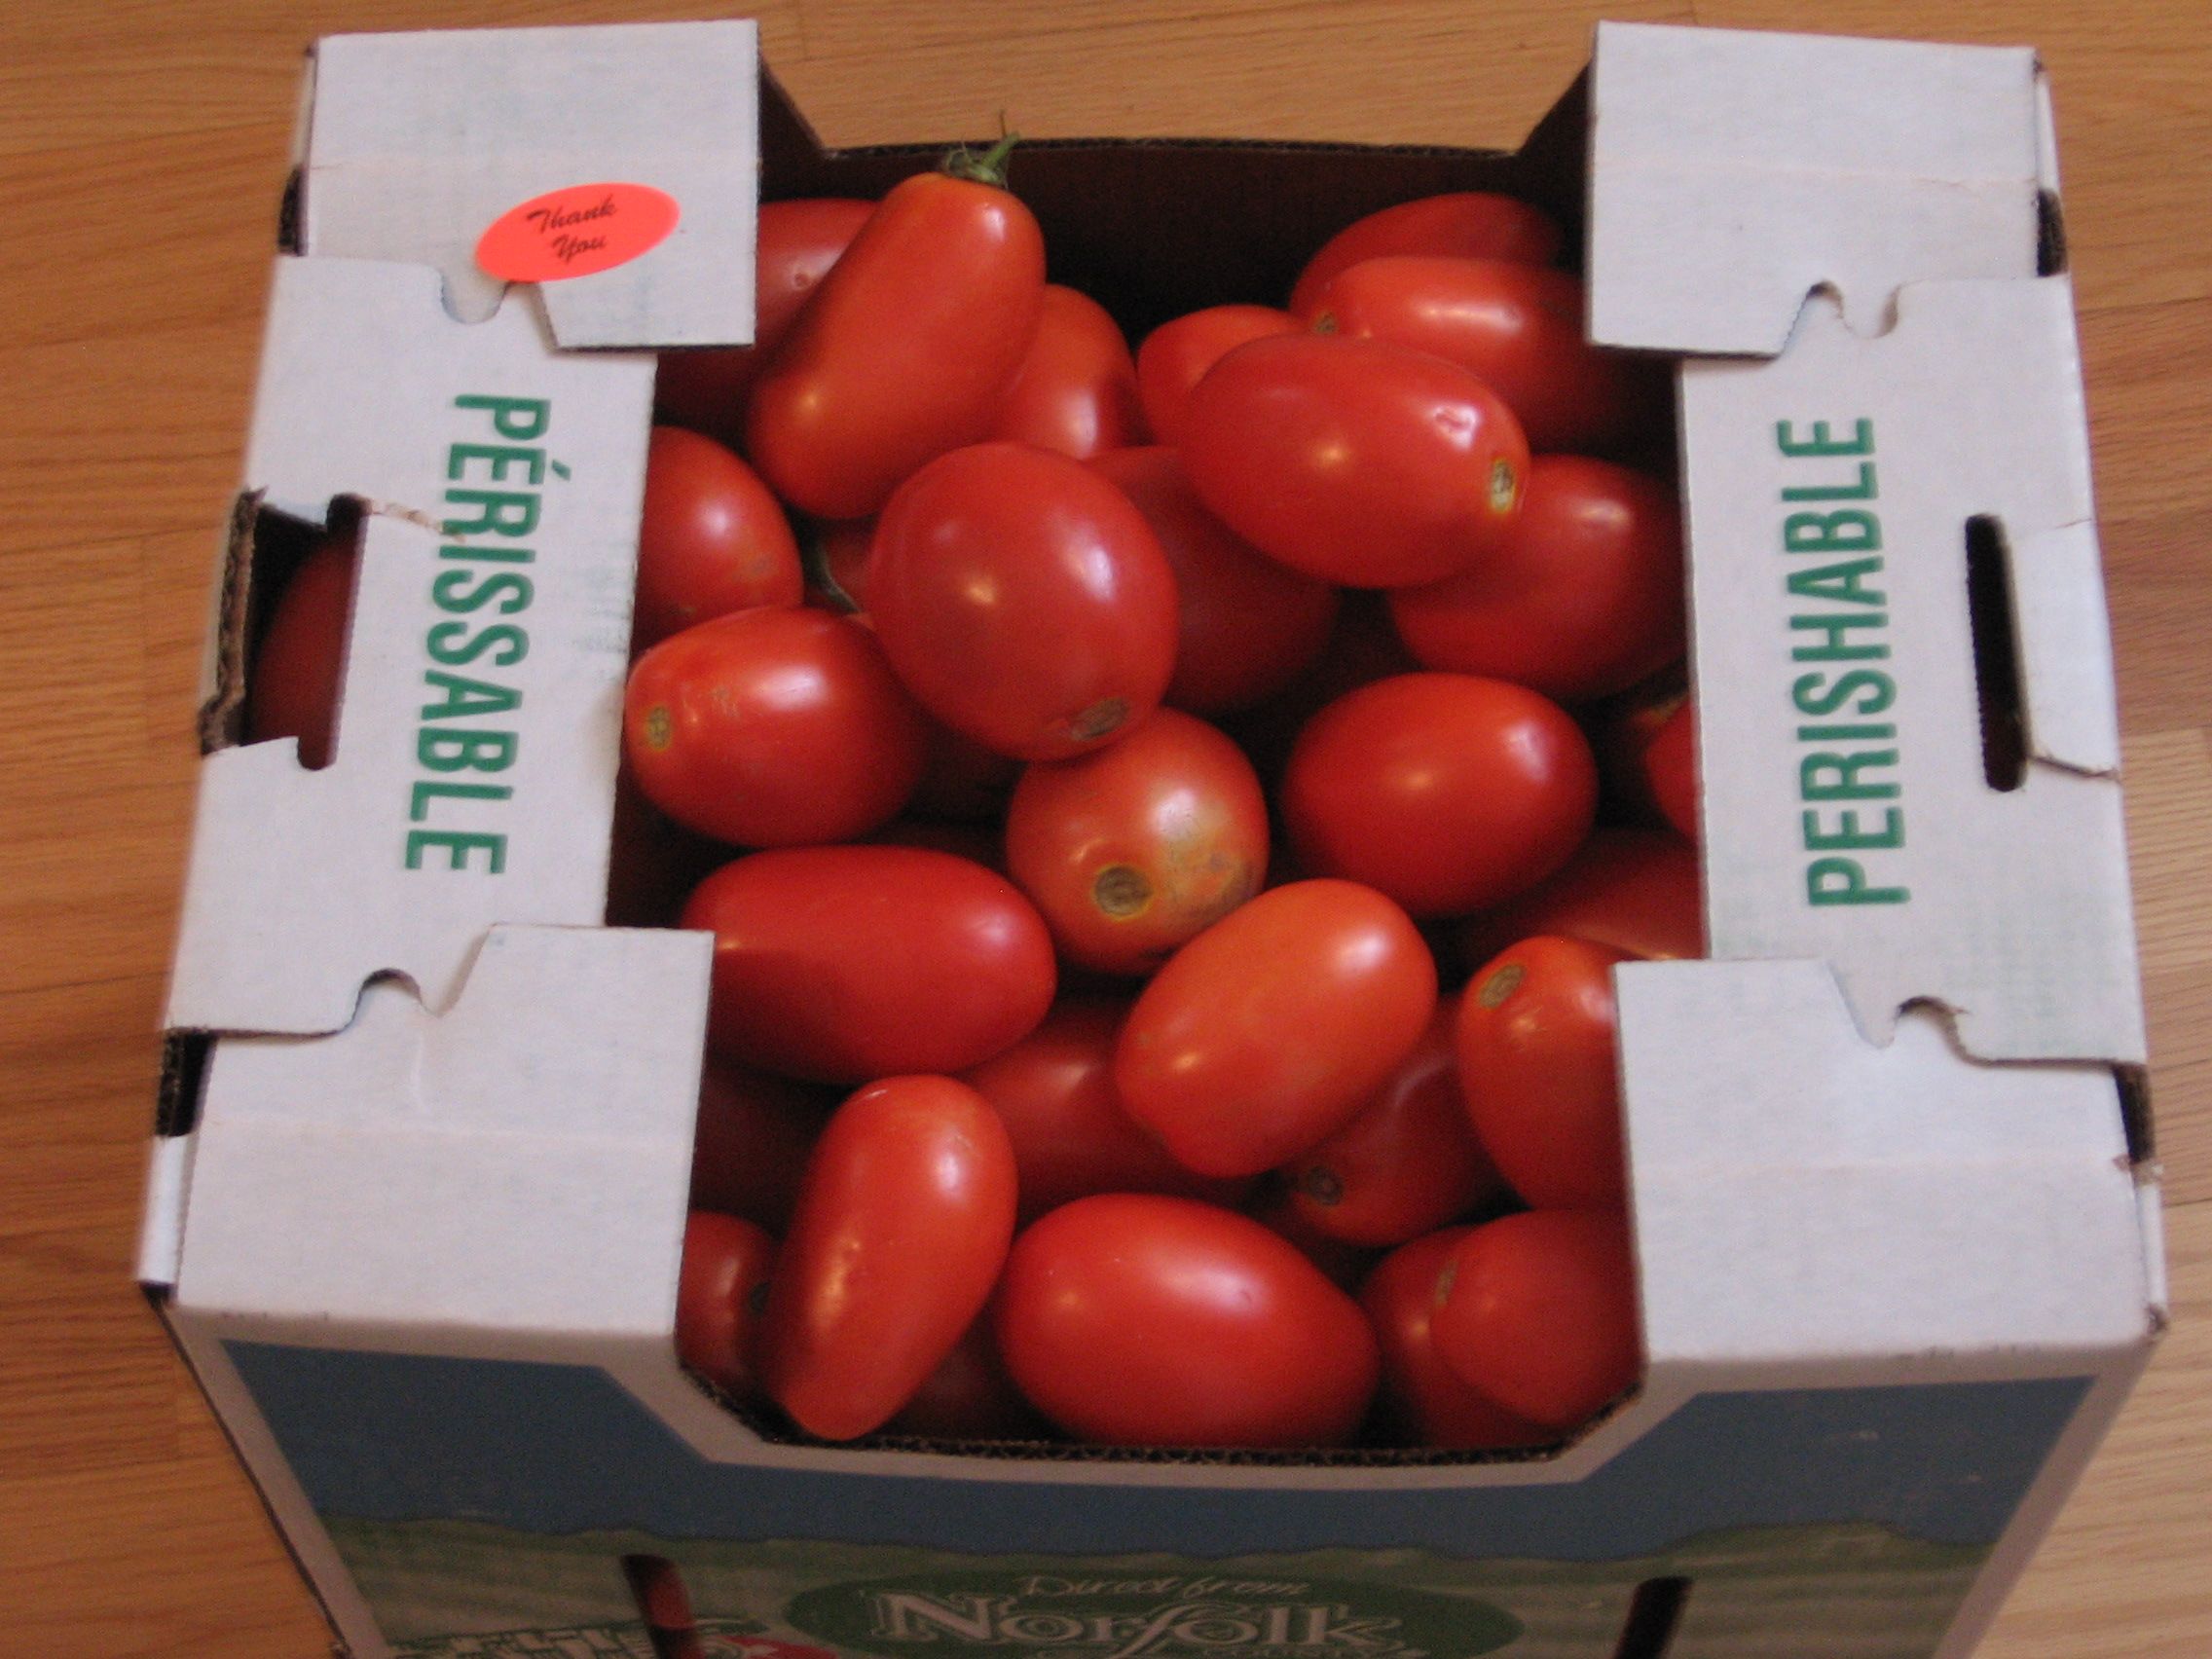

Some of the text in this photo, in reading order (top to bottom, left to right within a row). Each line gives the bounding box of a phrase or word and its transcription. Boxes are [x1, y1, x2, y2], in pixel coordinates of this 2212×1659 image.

[526, 193, 617, 235] Thank
[550, 234, 608, 265] You
[404, 393, 571, 875] PÉRISSABLE
[1776, 417, 1912, 906] PERISHABLE
[870, 1591, 1412, 1659] Norfolk
